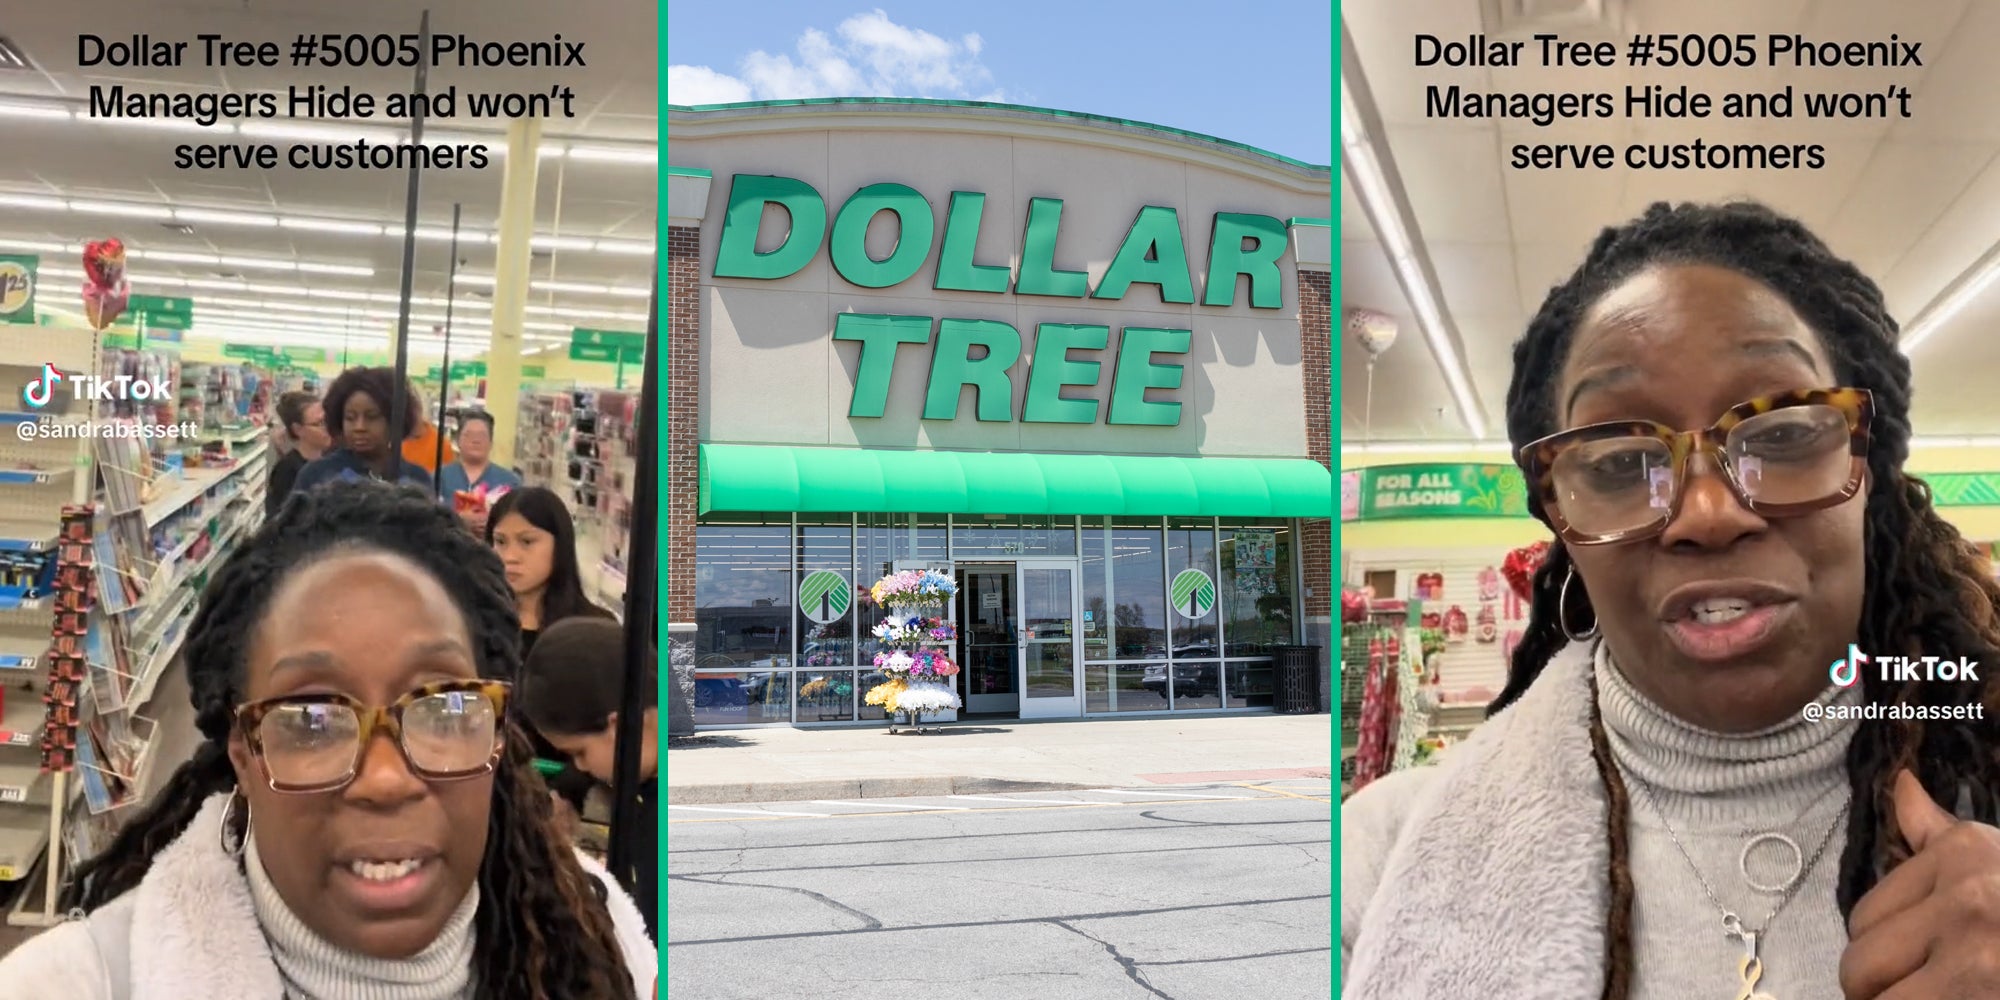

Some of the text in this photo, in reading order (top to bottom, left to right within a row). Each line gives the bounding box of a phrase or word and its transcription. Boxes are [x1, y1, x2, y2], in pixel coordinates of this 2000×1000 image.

[712, 173, 1289, 310] DOLLAR
[832, 311, 1193, 427] TREE
[1376, 472, 1453, 490] FOR ALL
[1375, 490, 1462, 508] SEASONS
[1004, 541, 1025, 554] 570
[820, 589, 829, 621] 1
[1189, 587, 1197, 617] 1
